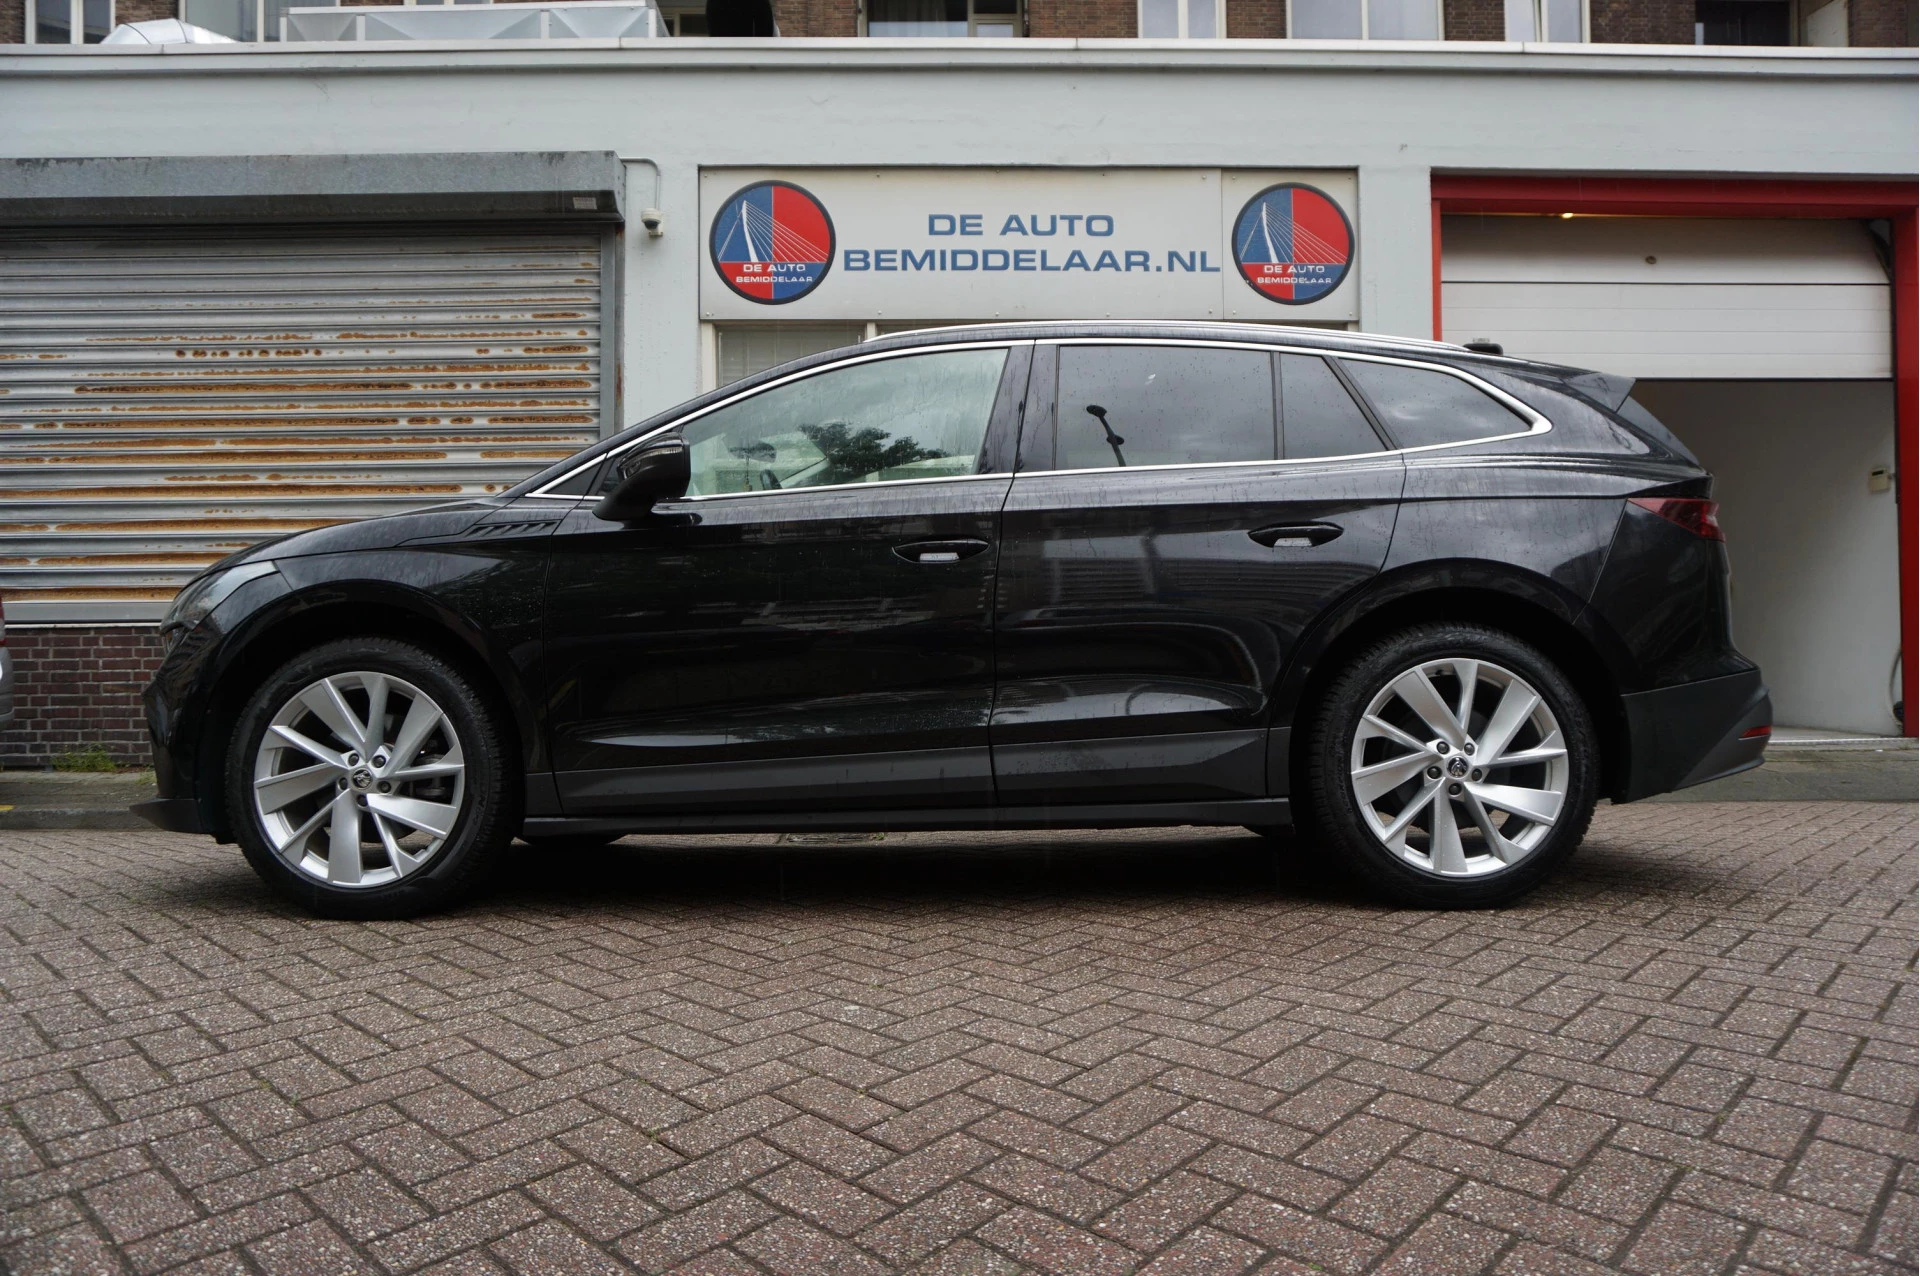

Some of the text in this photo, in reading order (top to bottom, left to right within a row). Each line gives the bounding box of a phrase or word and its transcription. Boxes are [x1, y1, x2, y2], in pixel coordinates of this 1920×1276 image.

[927, 213, 1115, 237] DE AUTO
[843, 248, 1222, 273] BEMIDDELAAR.NL
[743, 263, 806, 273] DE AUTO
[1263, 265, 1326, 274] DE AUTO
[735, 275, 814, 284] BEMIDDELAAR
[1256, 276, 1333, 285] BEMIDDELAAR
